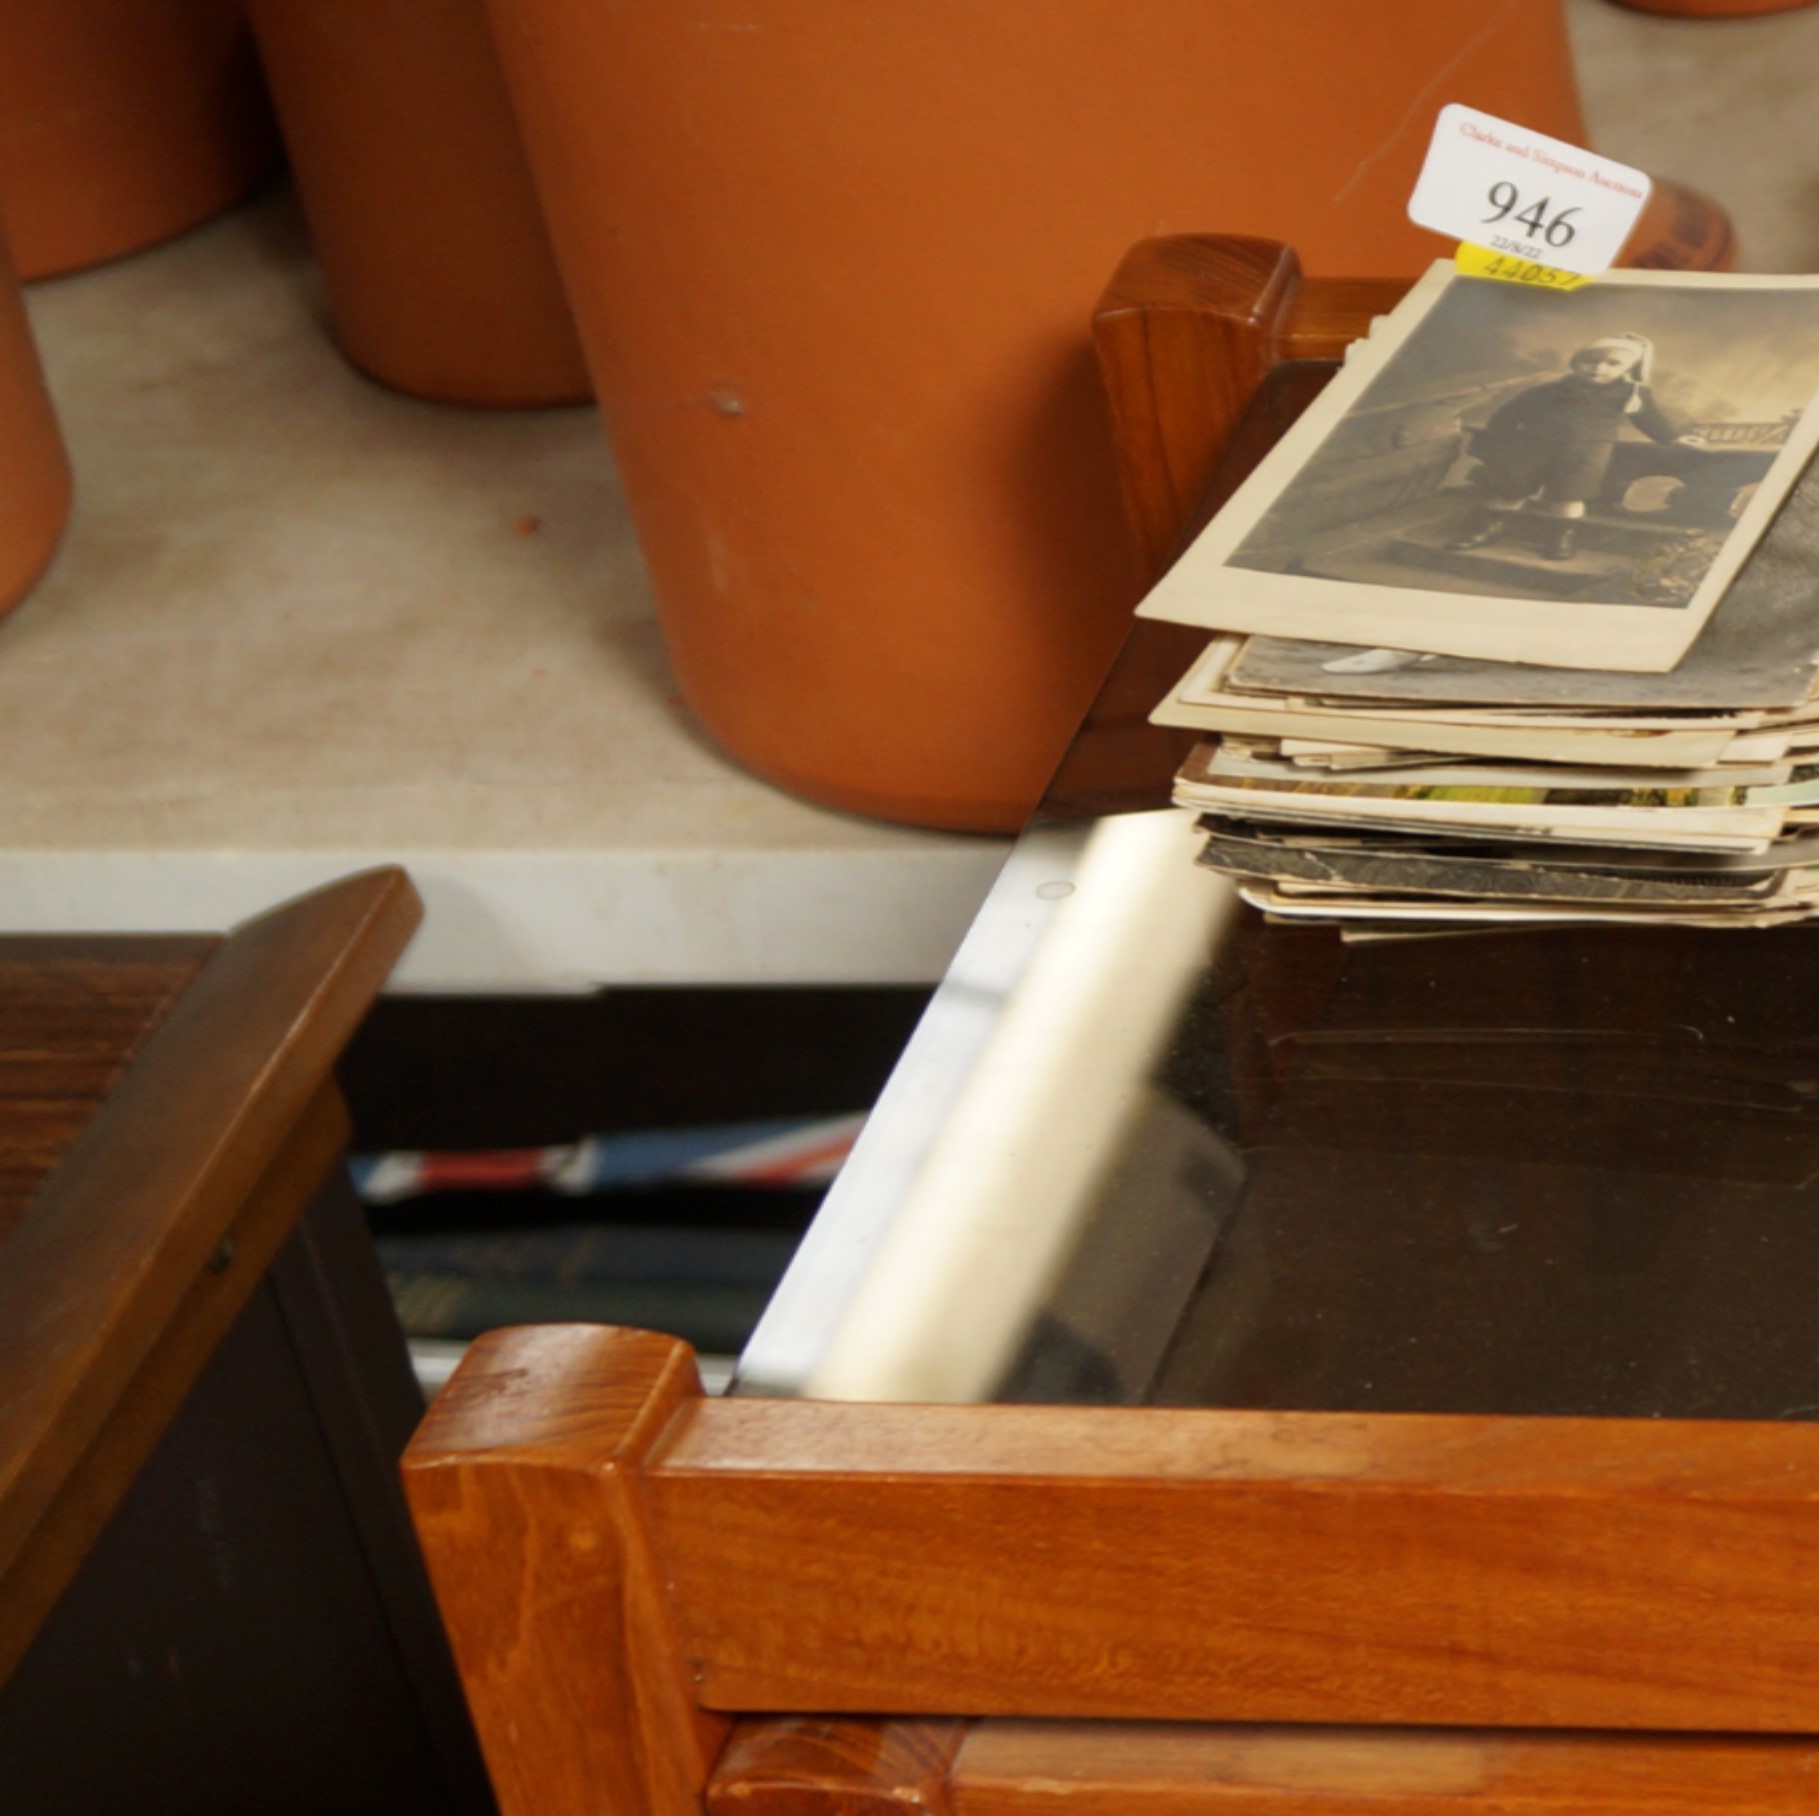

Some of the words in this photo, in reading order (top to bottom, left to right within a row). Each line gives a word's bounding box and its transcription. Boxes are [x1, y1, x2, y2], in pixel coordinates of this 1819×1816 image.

[1459, 121, 1503, 149] Clarke
[1505, 141, 1530, 159] and
[1532, 147, 1586, 179] Simpson
[1587, 170, 1644, 200] Auctions
[1480, 180, 1583, 248] 946
